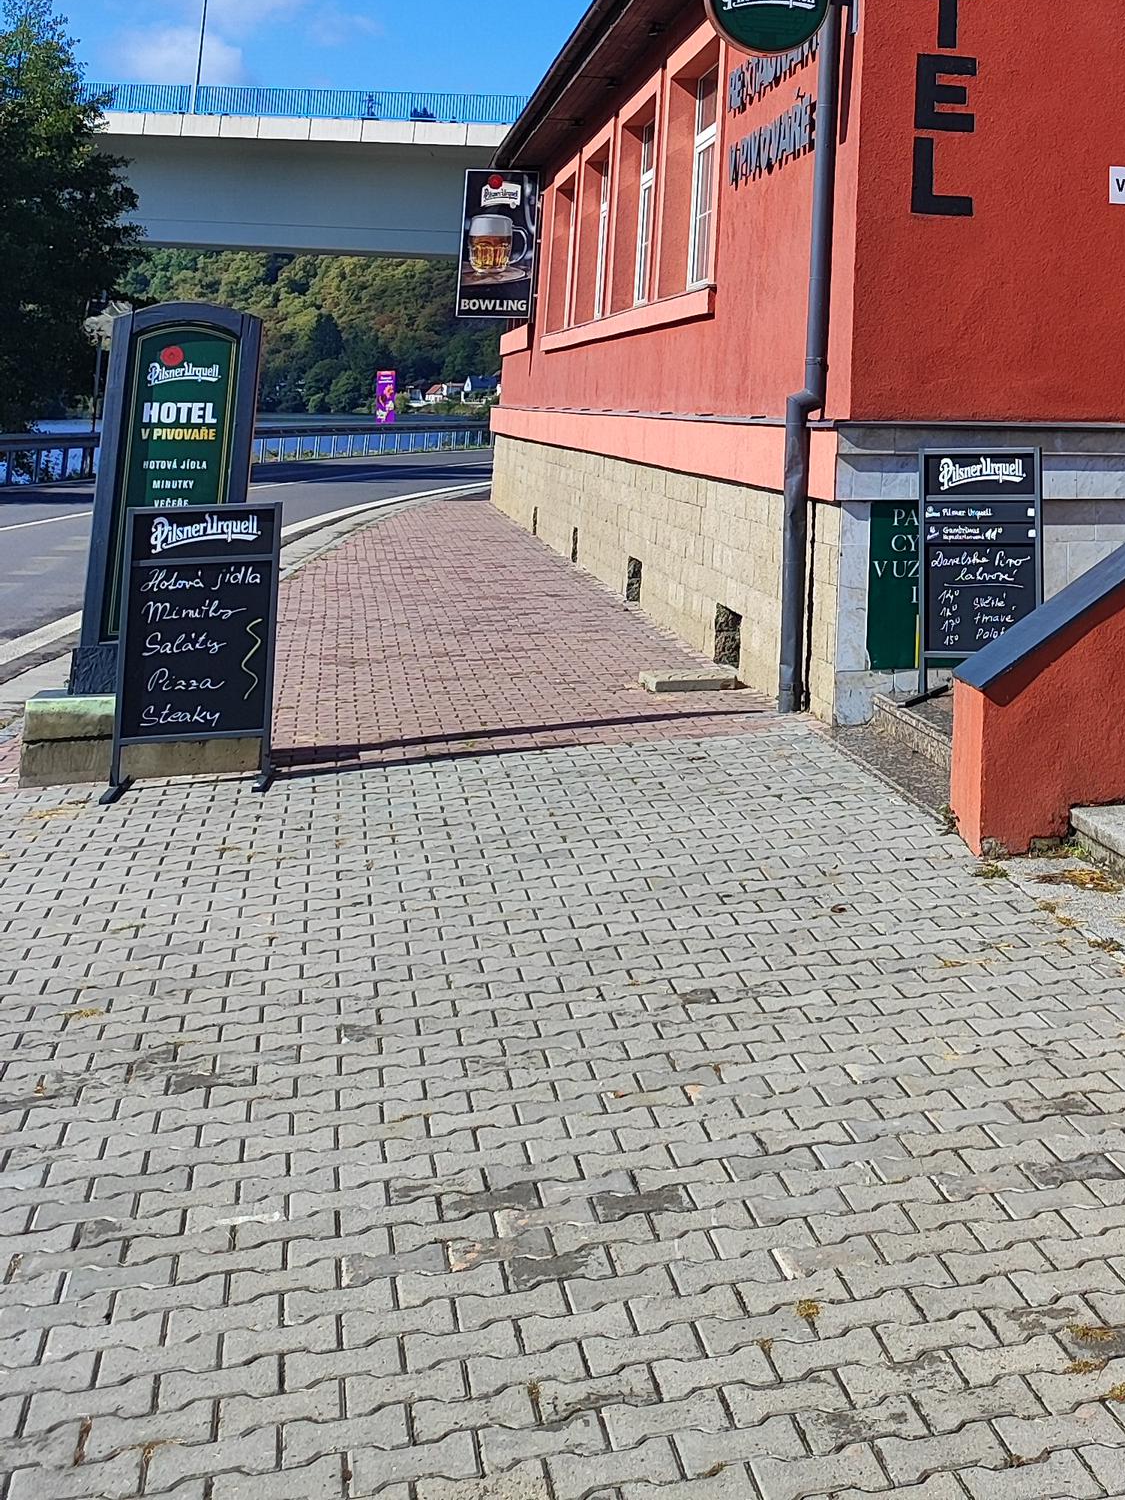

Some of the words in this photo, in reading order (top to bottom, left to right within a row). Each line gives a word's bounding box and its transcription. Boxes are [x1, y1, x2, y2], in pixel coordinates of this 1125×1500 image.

[460, 299, 527, 311] BOWLING
[147, 362, 185, 386] Pilsner
[142, 402, 217, 424] HOTEL
[141, 428, 150, 440] V
[153, 426, 216, 440] PIVOVAŘE
[143, 459, 178, 470] HOTOVÁ
[180, 459, 207, 470] JÍDLA
[939, 457, 983, 490] Pilsner
[152, 479, 194, 490] MINUTKY
[154, 497, 189, 507] VEČEŘE
[150, 515, 206, 554] Pilsner
[140, 568, 204, 592] Hotová
[211, 565, 261, 590] jídla
[873, 561, 888, 578] V
[142, 632, 227, 656] Saláty
[147, 667, 225, 692] Pizza
[140, 703, 220, 727] Steaky
